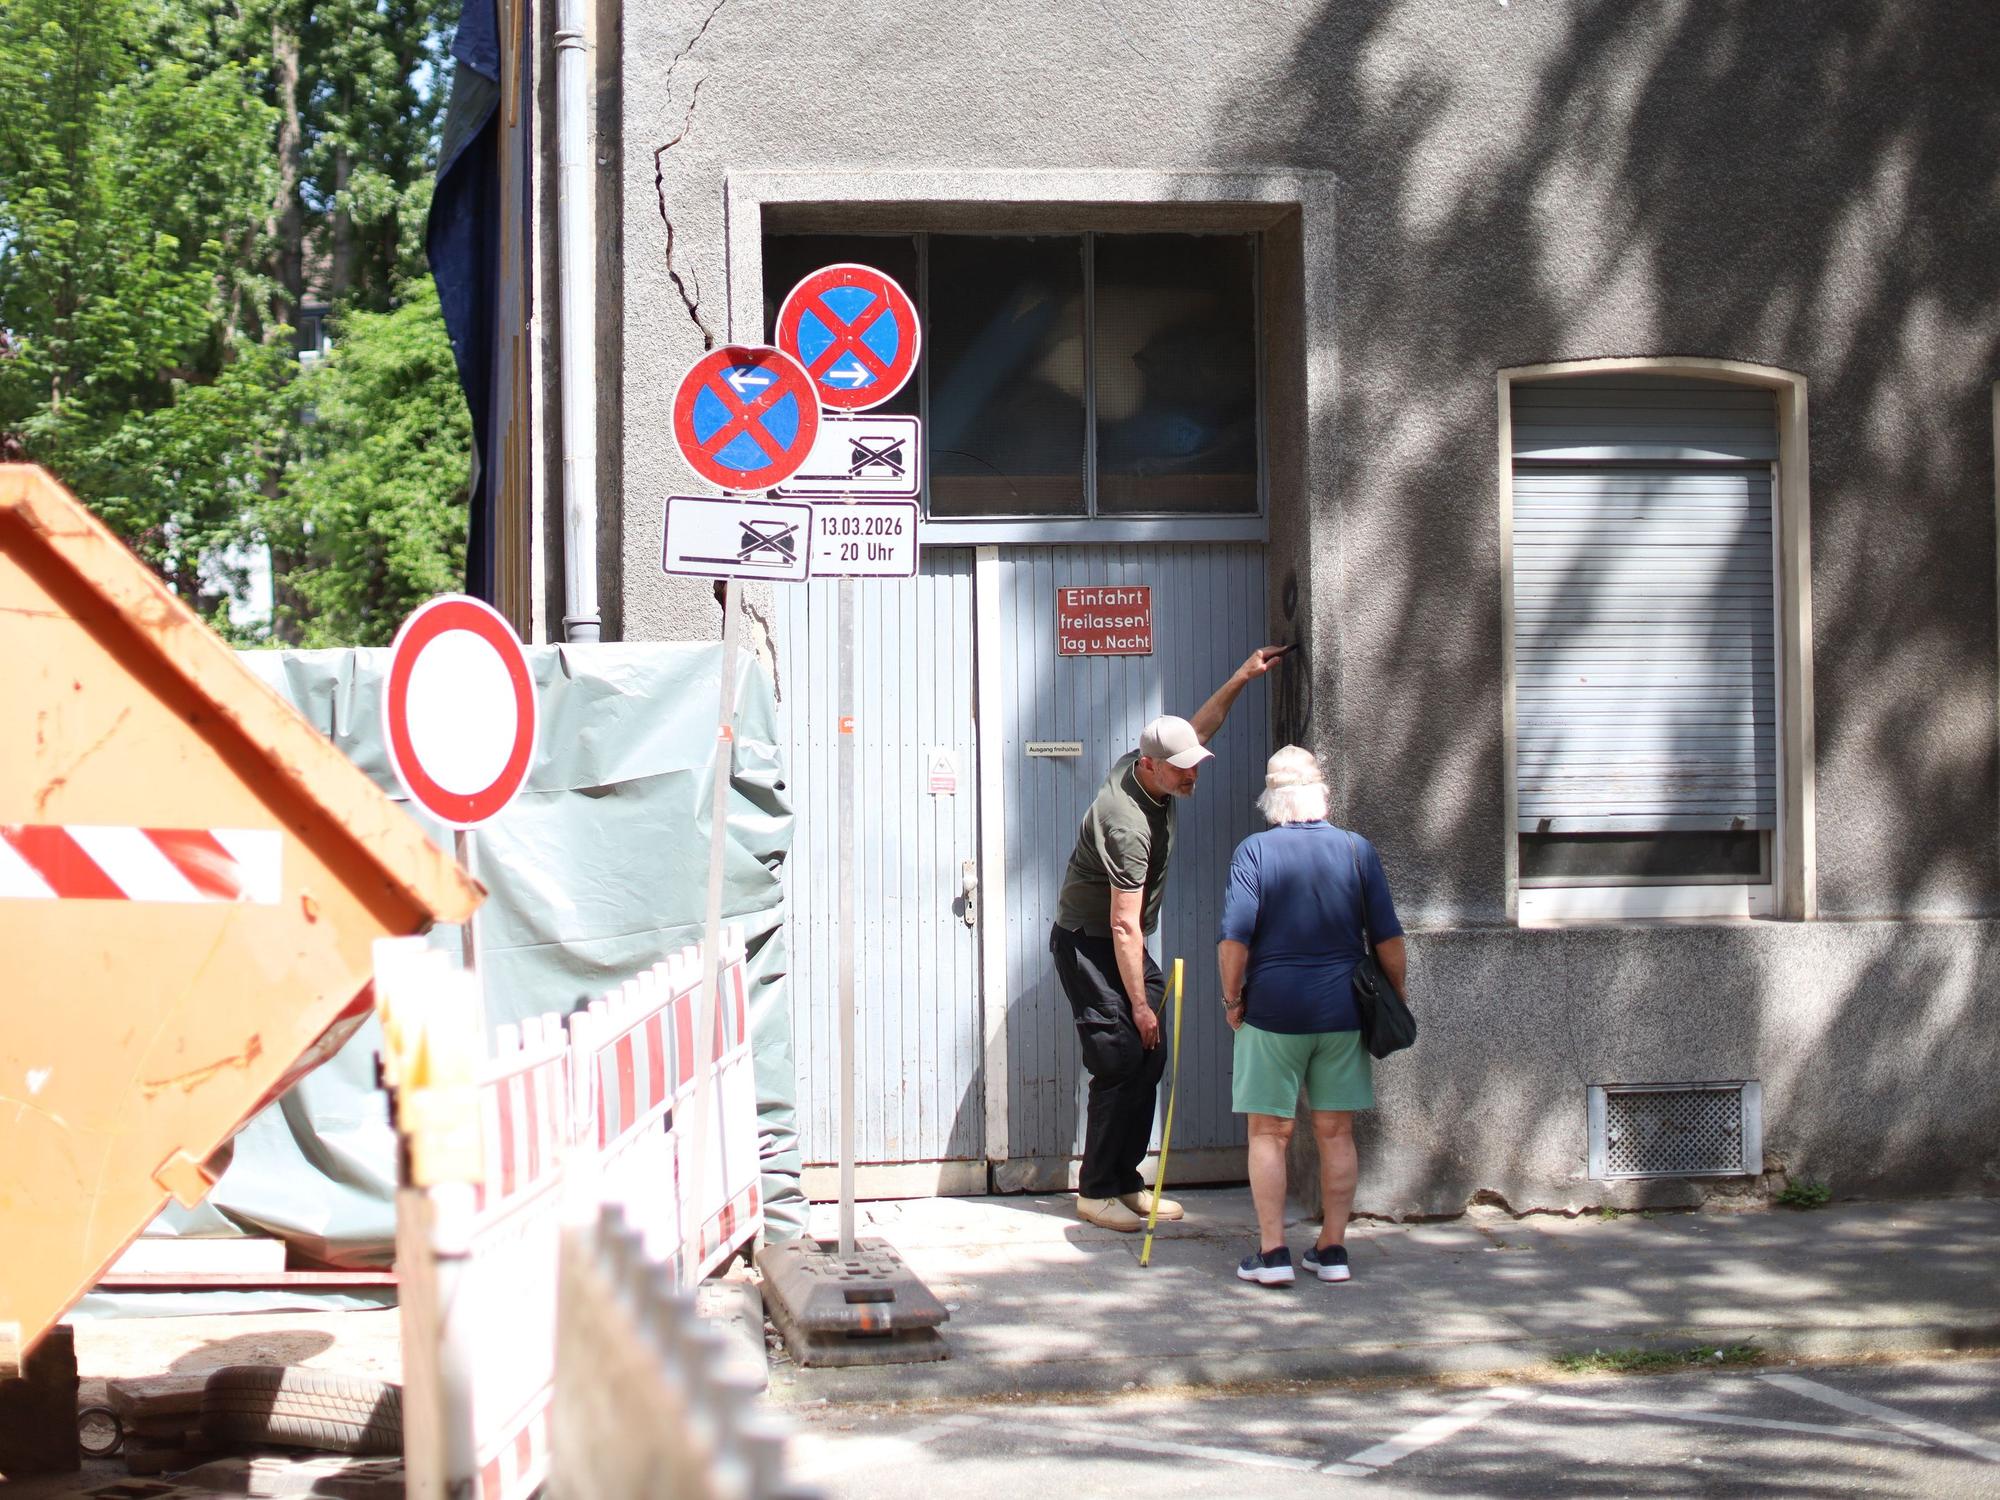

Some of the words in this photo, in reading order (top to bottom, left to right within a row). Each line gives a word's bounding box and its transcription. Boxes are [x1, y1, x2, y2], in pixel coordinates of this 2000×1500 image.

[821, 517, 902, 535] 13.03.2026
[840, 543, 859, 560] 20
[867, 543, 895, 560] Uhr
[1066, 589, 1143, 606] Einfahrt
[1060, 609, 1150, 629] freilassen!
[1061, 636, 1086, 652] Tag
[1091, 639, 1103, 649] u.
[1106, 634, 1150, 649] Nacht
